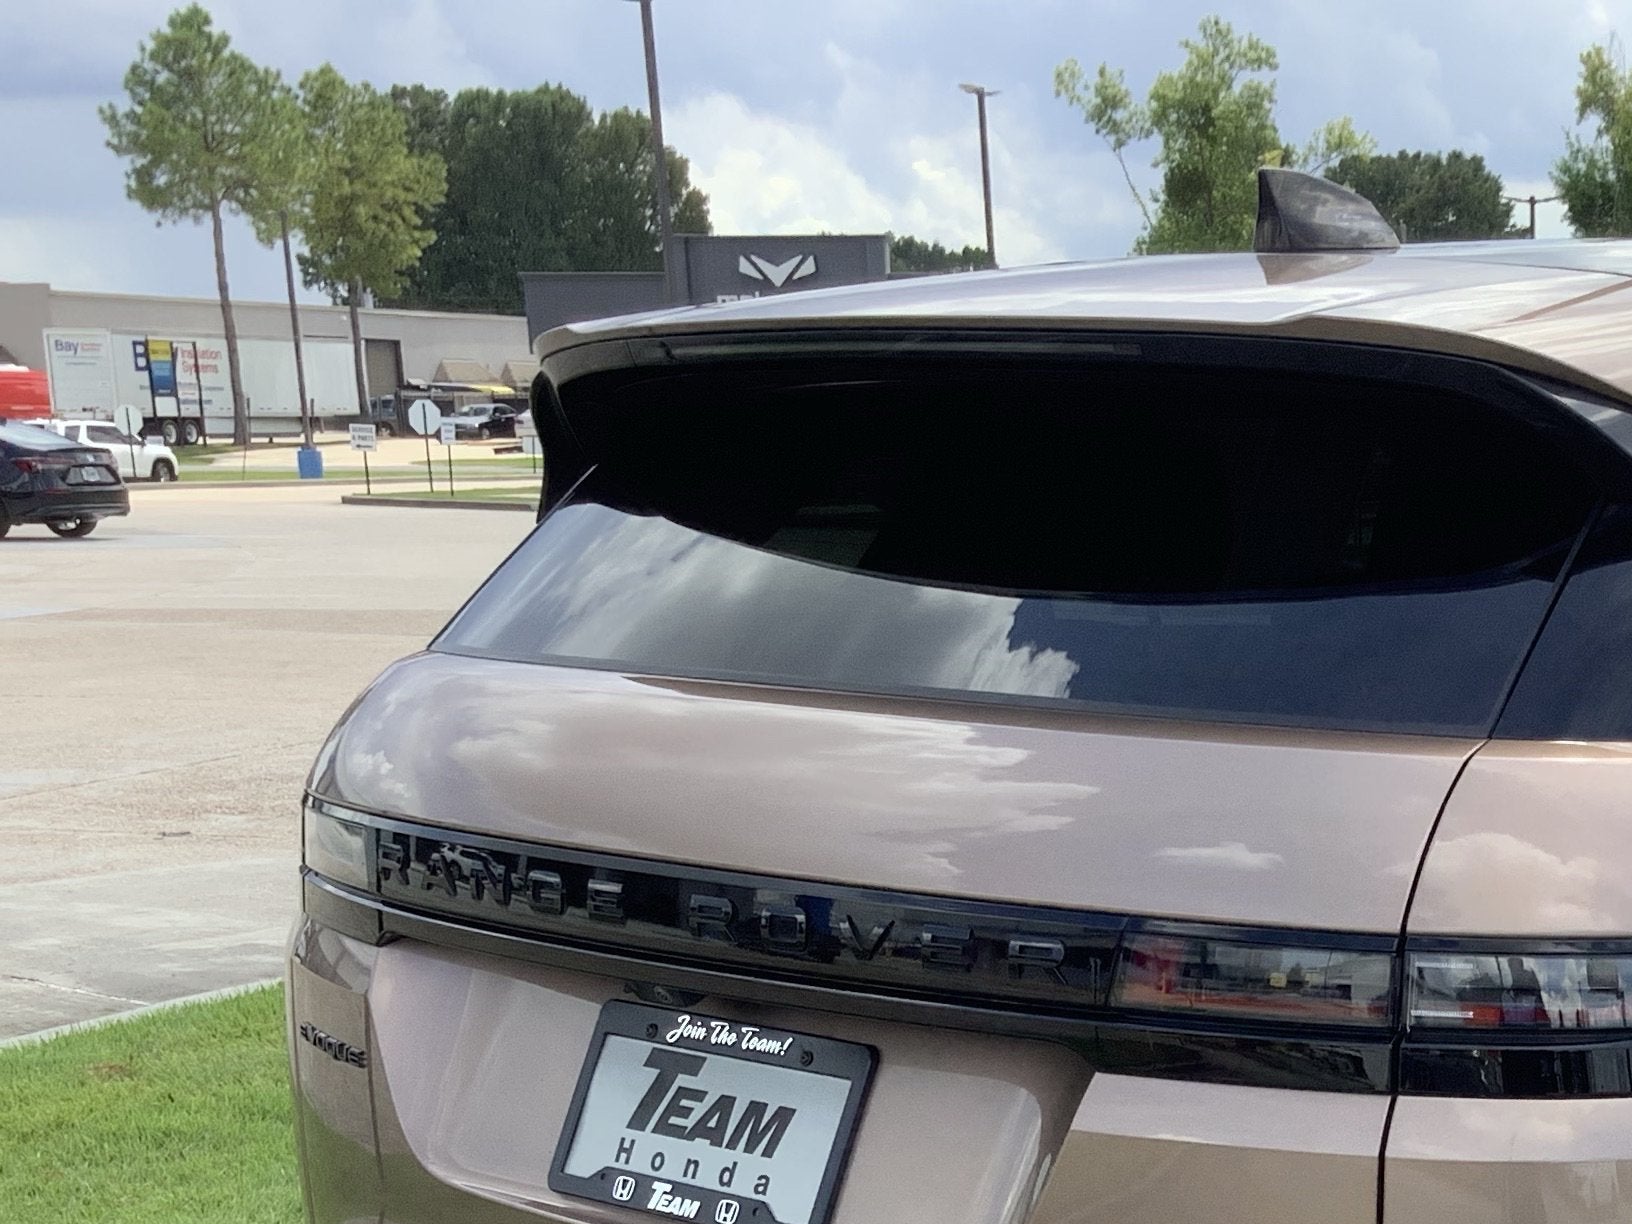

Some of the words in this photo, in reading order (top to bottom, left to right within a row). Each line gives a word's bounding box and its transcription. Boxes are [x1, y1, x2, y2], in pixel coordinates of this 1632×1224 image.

[55, 339, 79, 355] Bay
[379, 842, 629, 920] RANGE
[687, 893, 1069, 987] ROVER
[300, 1022, 367, 1069] EVOQUE
[666, 1014, 707, 1043] Join
[710, 1021, 738, 1045] The
[741, 1026, 793, 1056] Team!
[625, 1046, 797, 1159] TEAM
[614, 1136, 770, 1197] Honda
[647, 1180, 701, 1219] TEAM
